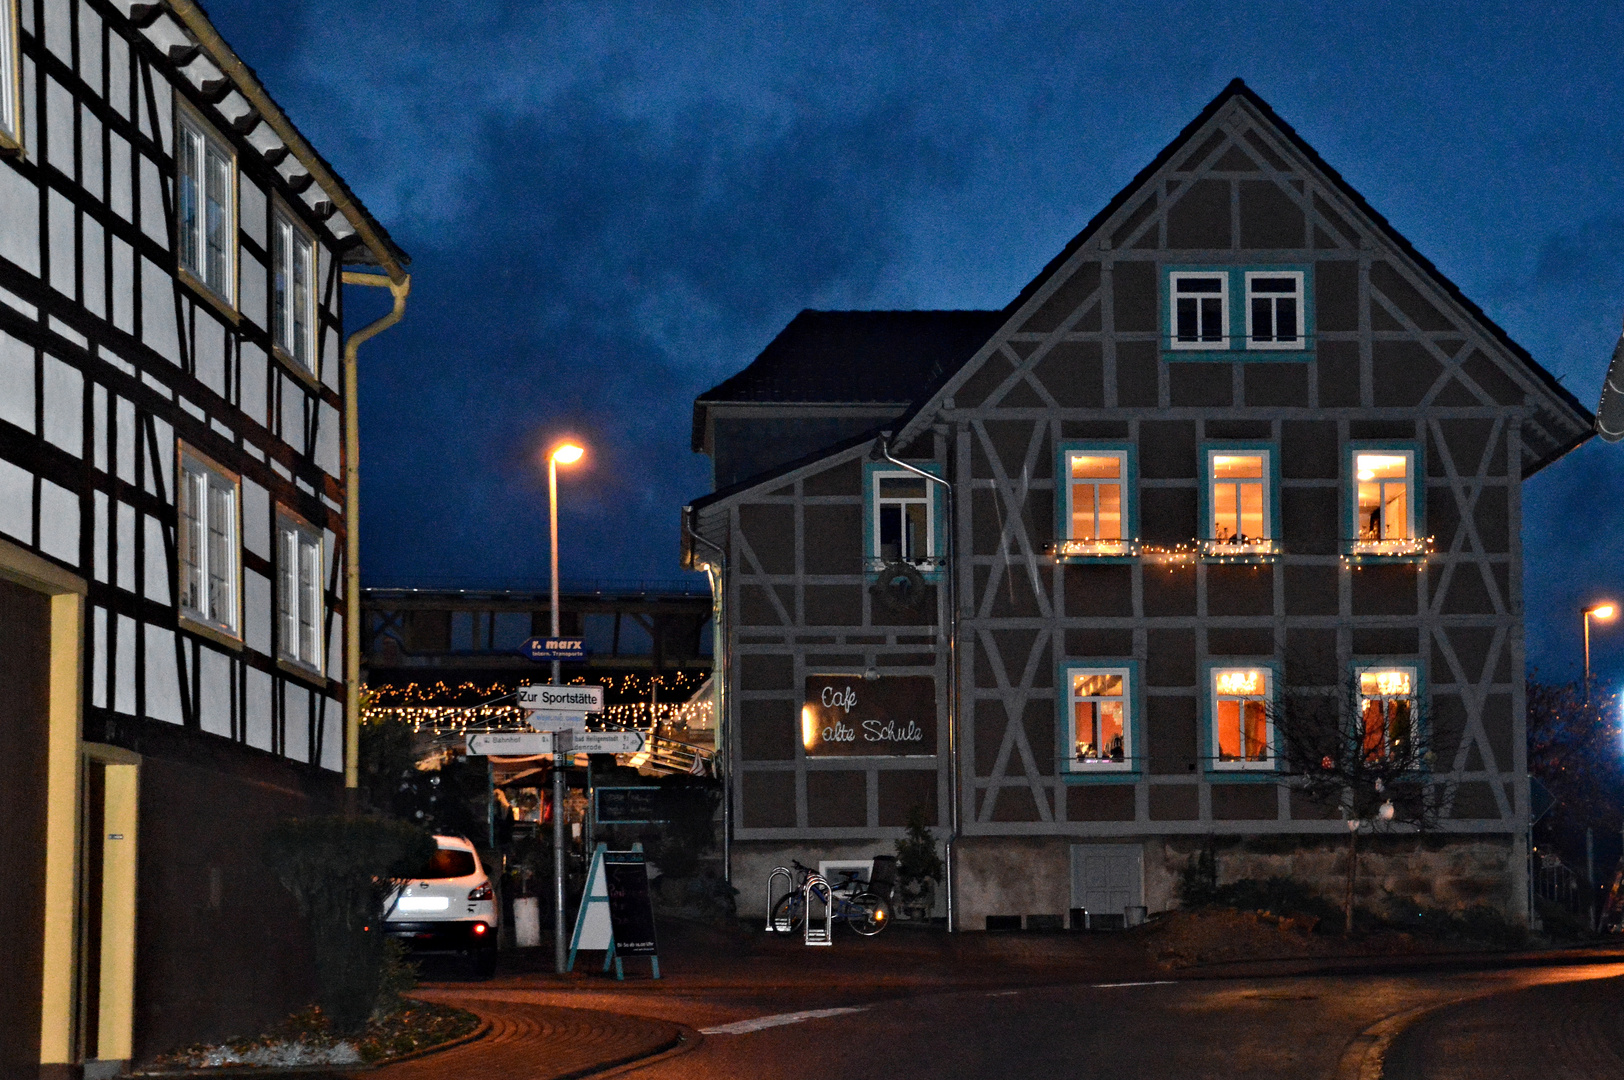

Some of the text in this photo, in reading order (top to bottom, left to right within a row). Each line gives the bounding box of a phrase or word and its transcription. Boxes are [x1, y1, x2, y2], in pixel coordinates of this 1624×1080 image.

[531, 640, 582, 650] r. marx
[520, 691, 598, 705] Zur Sportstätte
[822, 719, 923, 742] alte Schule
